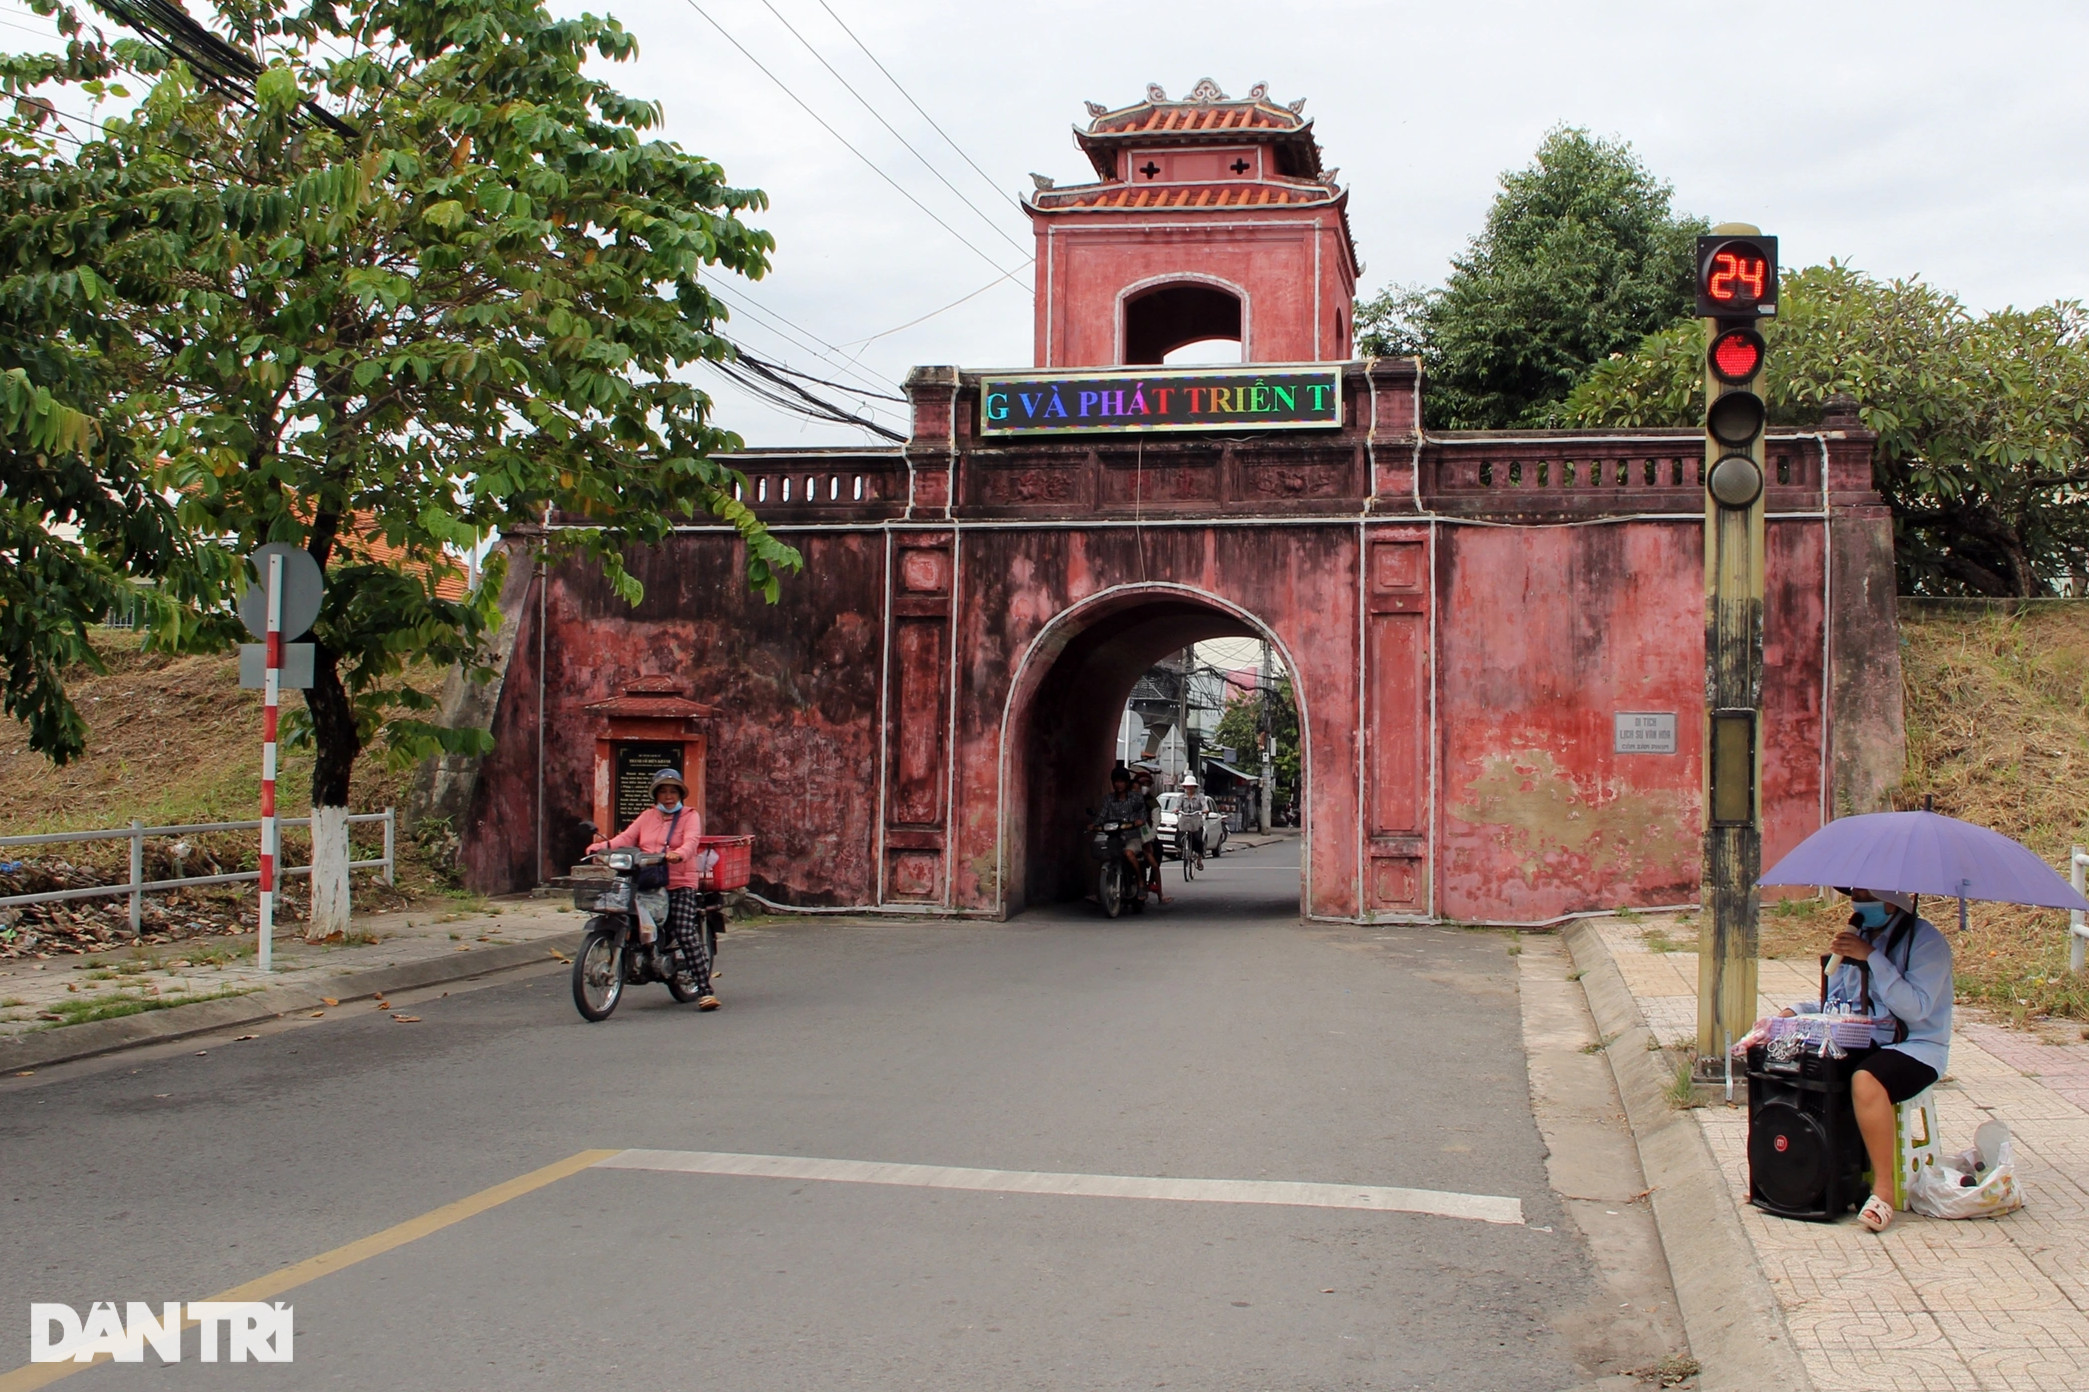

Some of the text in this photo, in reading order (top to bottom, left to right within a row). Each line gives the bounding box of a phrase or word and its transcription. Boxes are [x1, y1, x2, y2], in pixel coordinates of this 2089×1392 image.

[1710, 253, 1764, 299] 24
[986, 392, 1009, 420] G
[1018, 385, 1069, 419] VÀ
[1077, 380, 1176, 417] PHÁT
